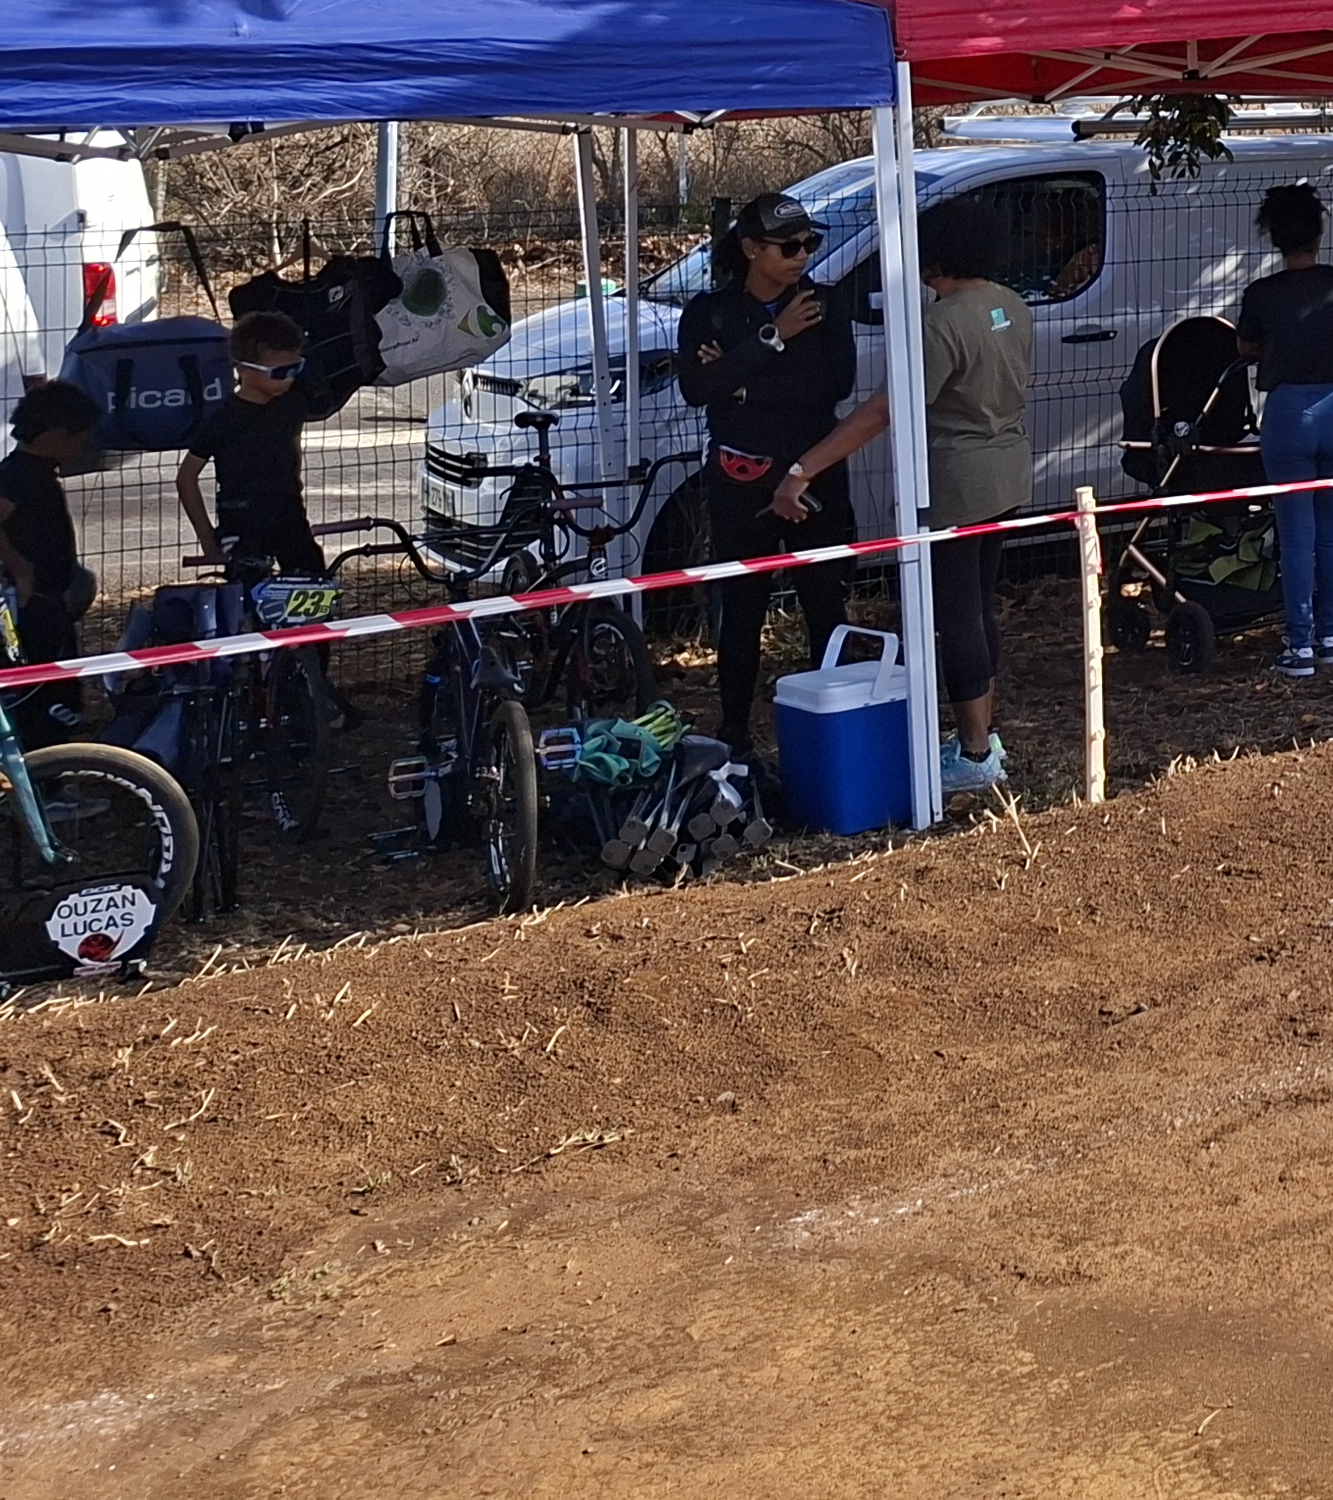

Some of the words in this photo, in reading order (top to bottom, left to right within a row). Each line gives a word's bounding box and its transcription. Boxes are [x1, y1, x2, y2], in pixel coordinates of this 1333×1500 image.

[287, 589, 325, 618] 23
[56, 892, 136, 920] OUZAN
[60, 911, 135, 938] LUCAS
